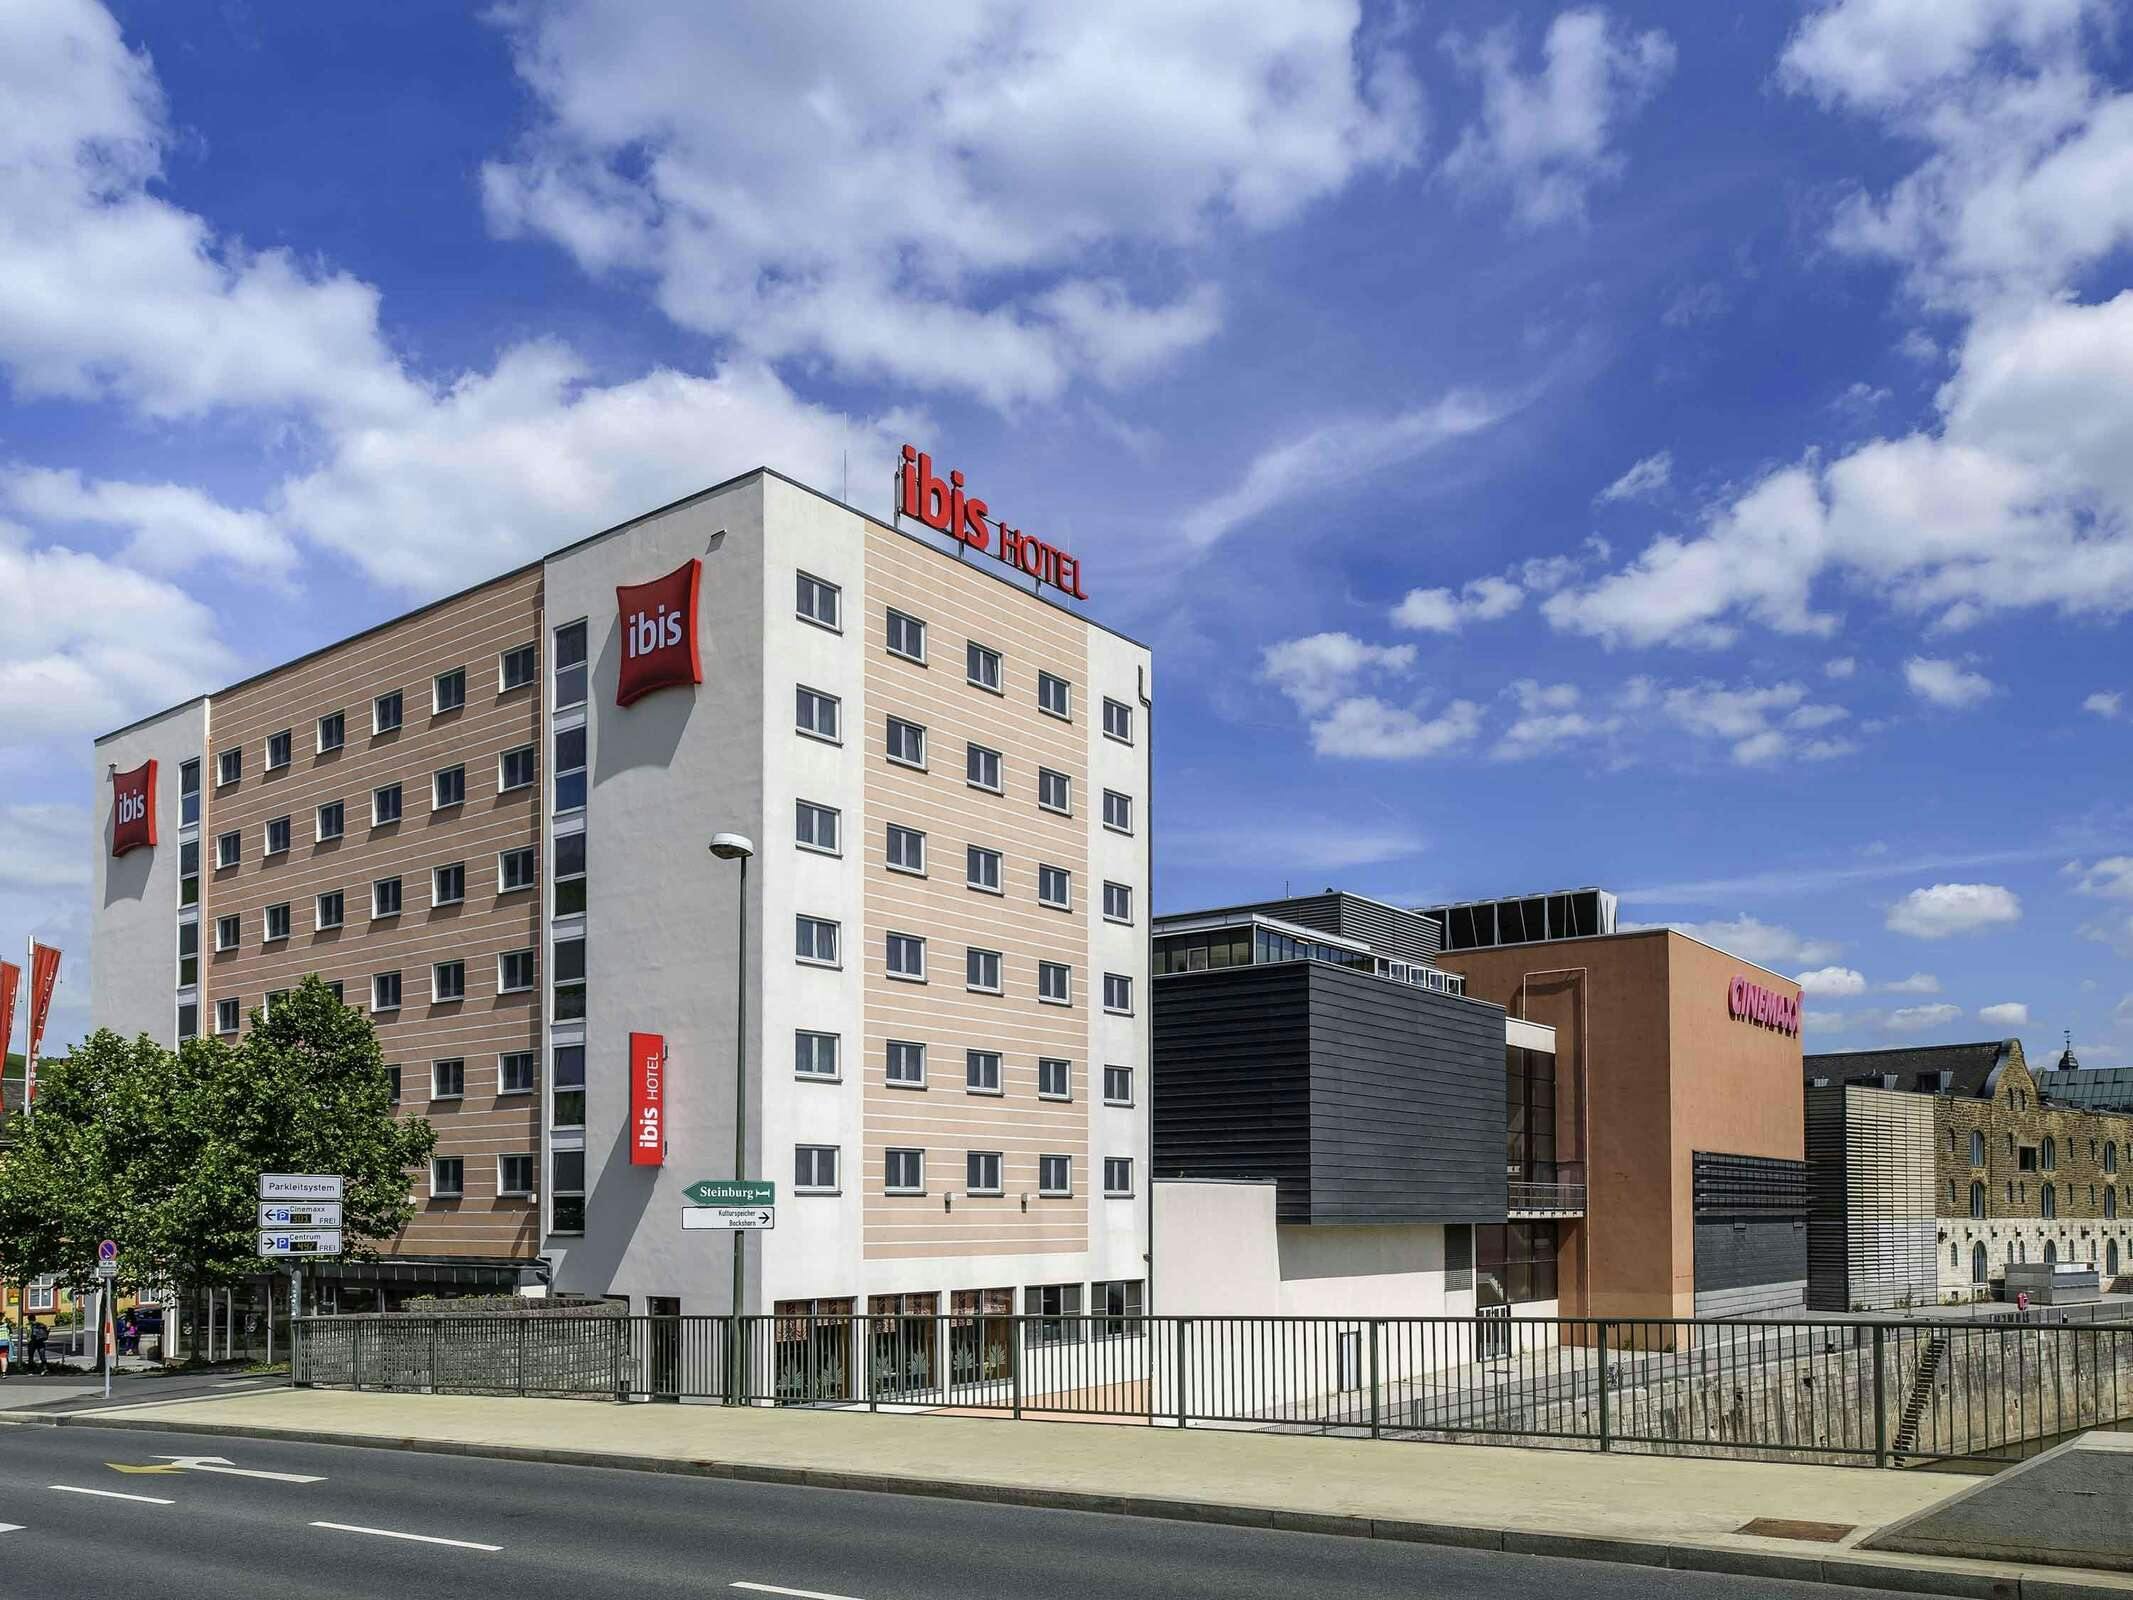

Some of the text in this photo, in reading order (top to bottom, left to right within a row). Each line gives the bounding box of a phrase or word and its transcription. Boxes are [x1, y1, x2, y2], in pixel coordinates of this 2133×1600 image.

[902, 443, 1088, 600] ibis HOTEL
[629, 604, 682, 658] ibis
[118, 789, 145, 825] ibis
[1728, 975, 1806, 1034] CINEMAXX
[640, 1052, 659, 1148] ibis HOTEL
[269, 1182, 335, 1192] Parkleitsystem
[699, 1186, 754, 1200] Steinburg
[289, 1205, 325, 1213] Cinemaxx
[718, 1209, 756, 1218] Kulturspeicher
